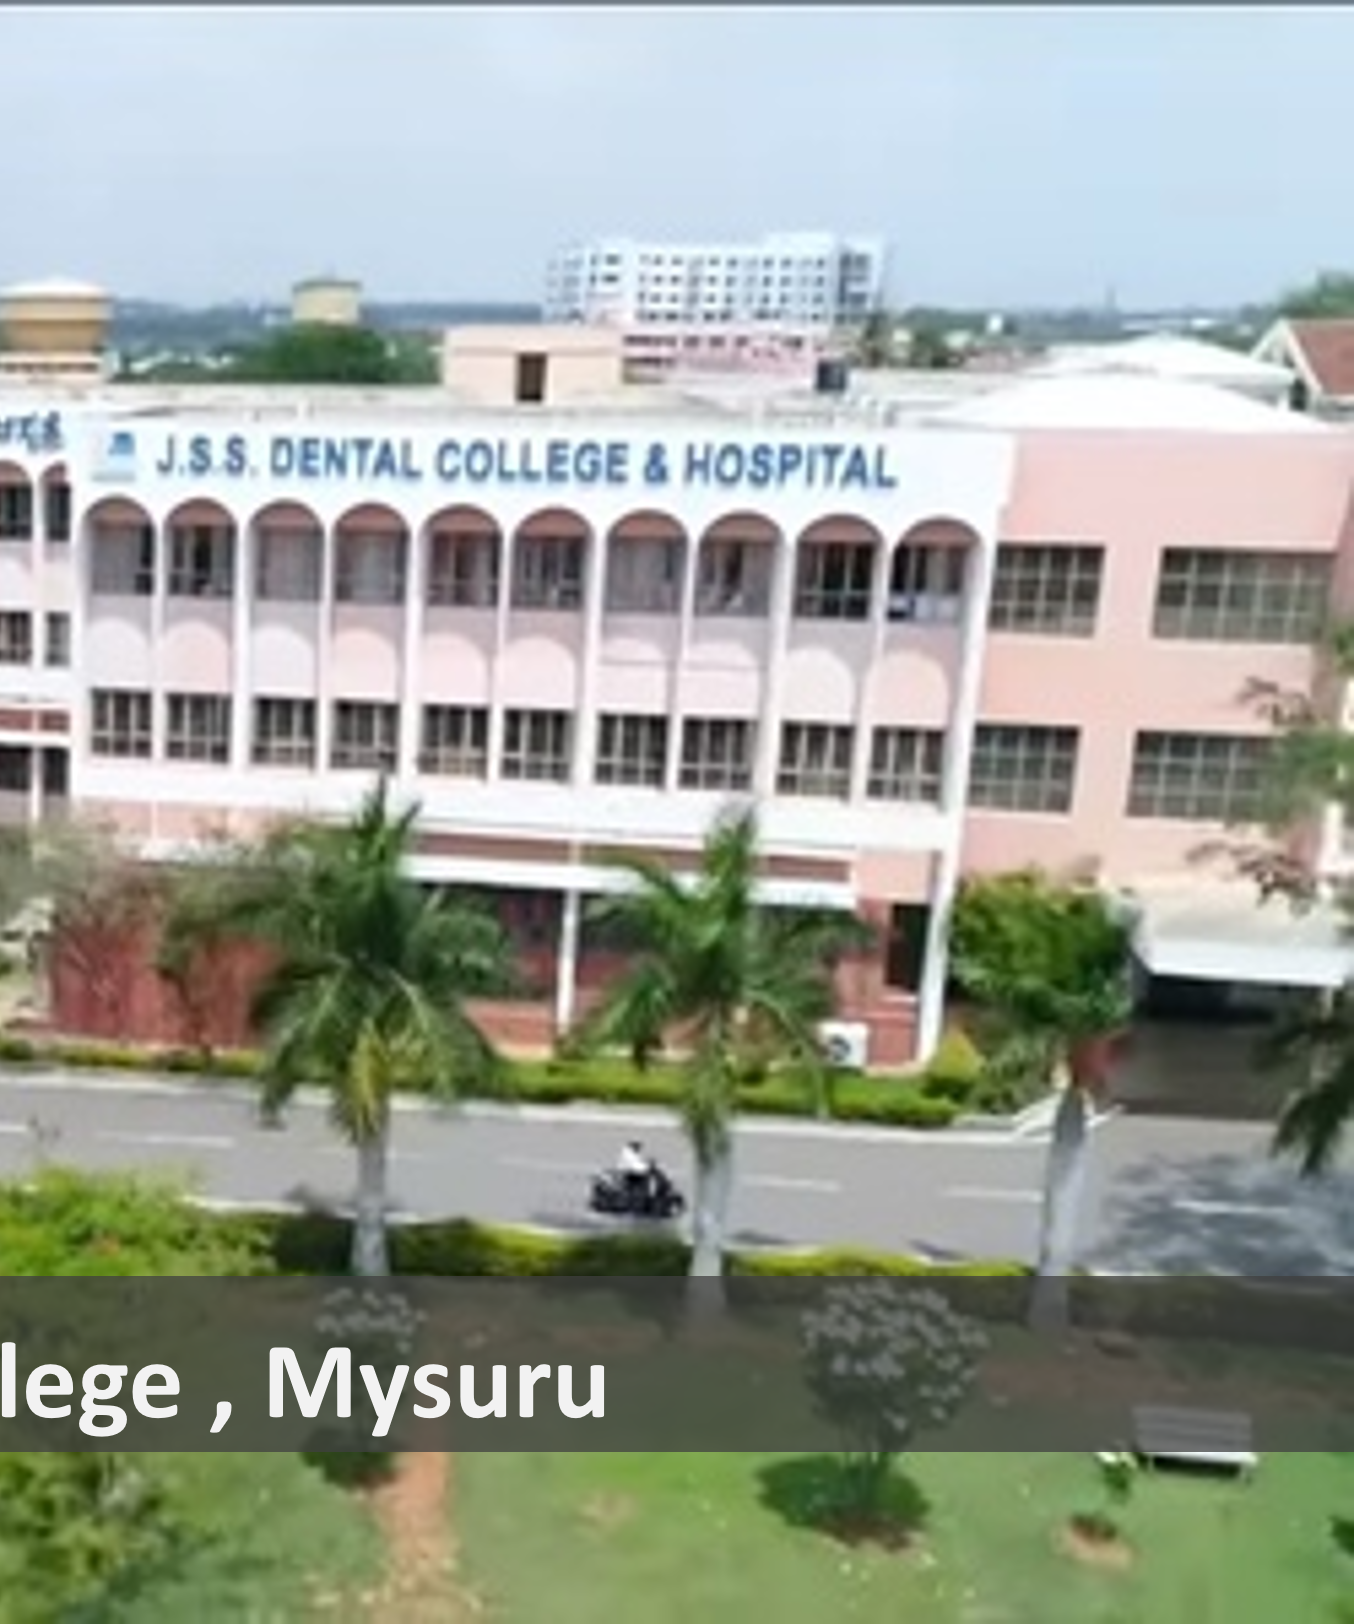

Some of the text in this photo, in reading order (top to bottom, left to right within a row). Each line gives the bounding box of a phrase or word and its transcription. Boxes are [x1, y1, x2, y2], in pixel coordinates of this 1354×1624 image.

[156, 434, 898, 488] J.S.S. DENTAL COLLEGE & HOSPITAL
